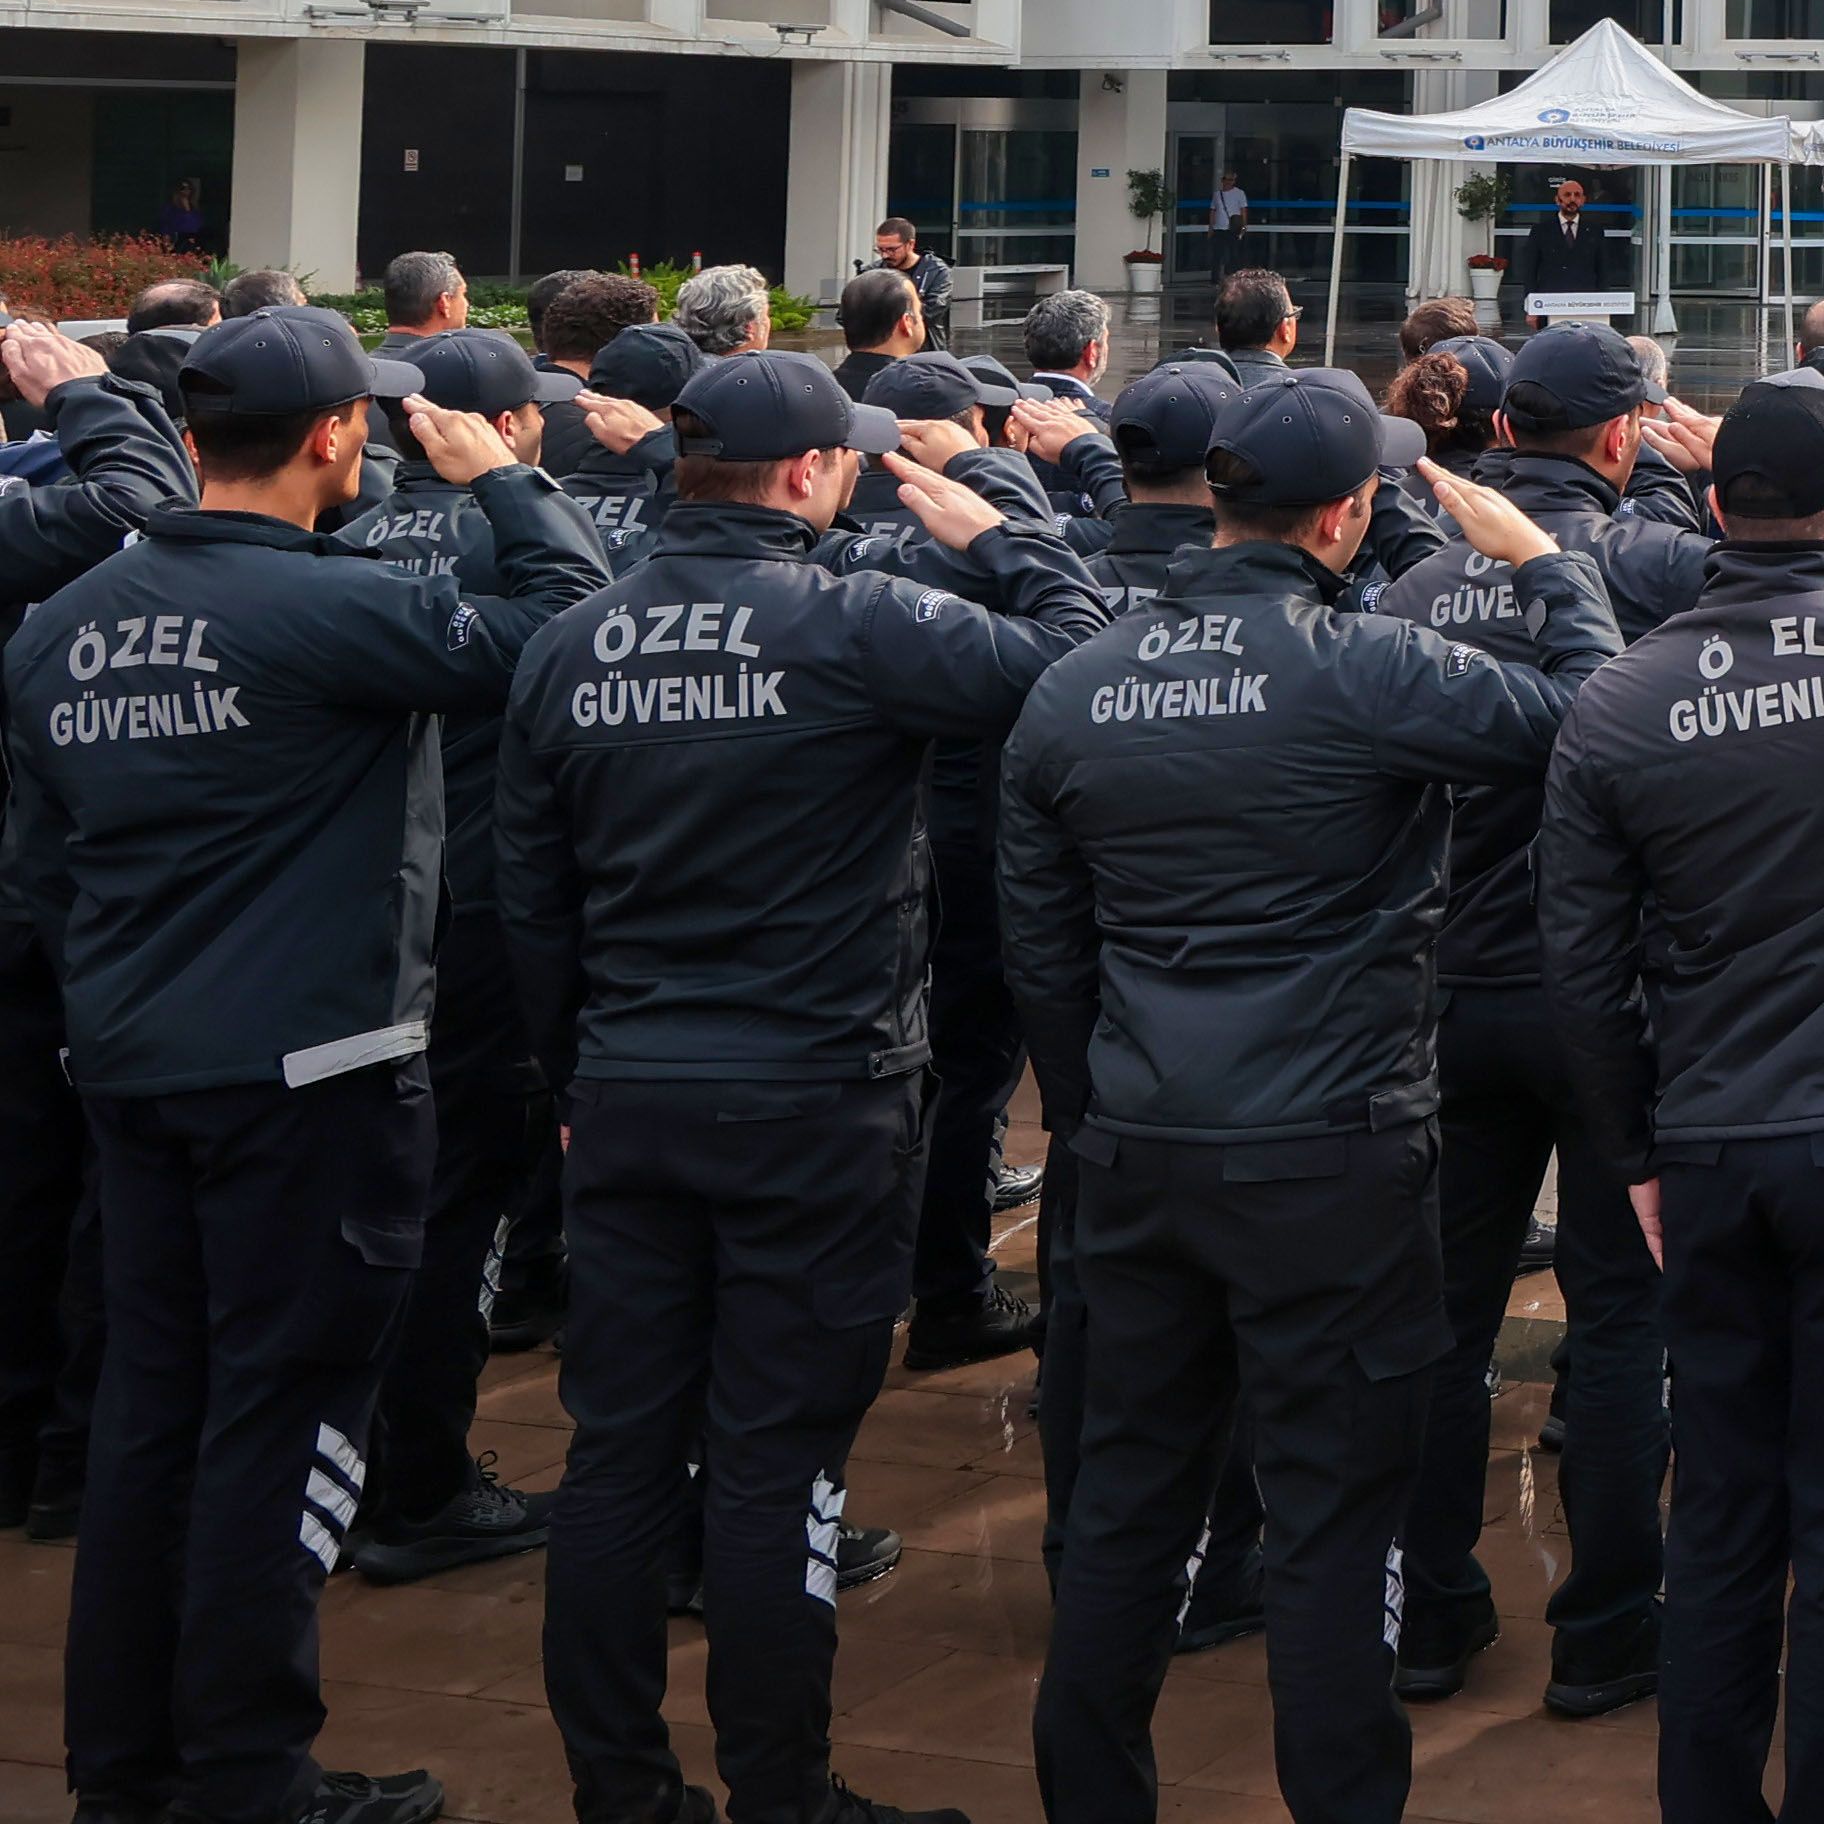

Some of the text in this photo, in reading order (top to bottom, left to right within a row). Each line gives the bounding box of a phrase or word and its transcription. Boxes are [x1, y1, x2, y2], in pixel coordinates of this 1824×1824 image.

[1486, 135, 1681, 153] ANTALYA BÜYÜKŞEHİR BELEDİYESİ
[365, 509, 446, 548] ÖZEL
[575, 496, 649, 533] ZEL
[67, 613, 220, 682] ÖZEL
[593, 602, 762, 664] ÖZEL
[1137, 614, 1245, 664] ÖZEL
[48, 681, 251, 747] GÜVENLİK
[571, 662, 787, 729] GÜVENLİK
[1091, 666, 1270, 725] GÜVENLİK
